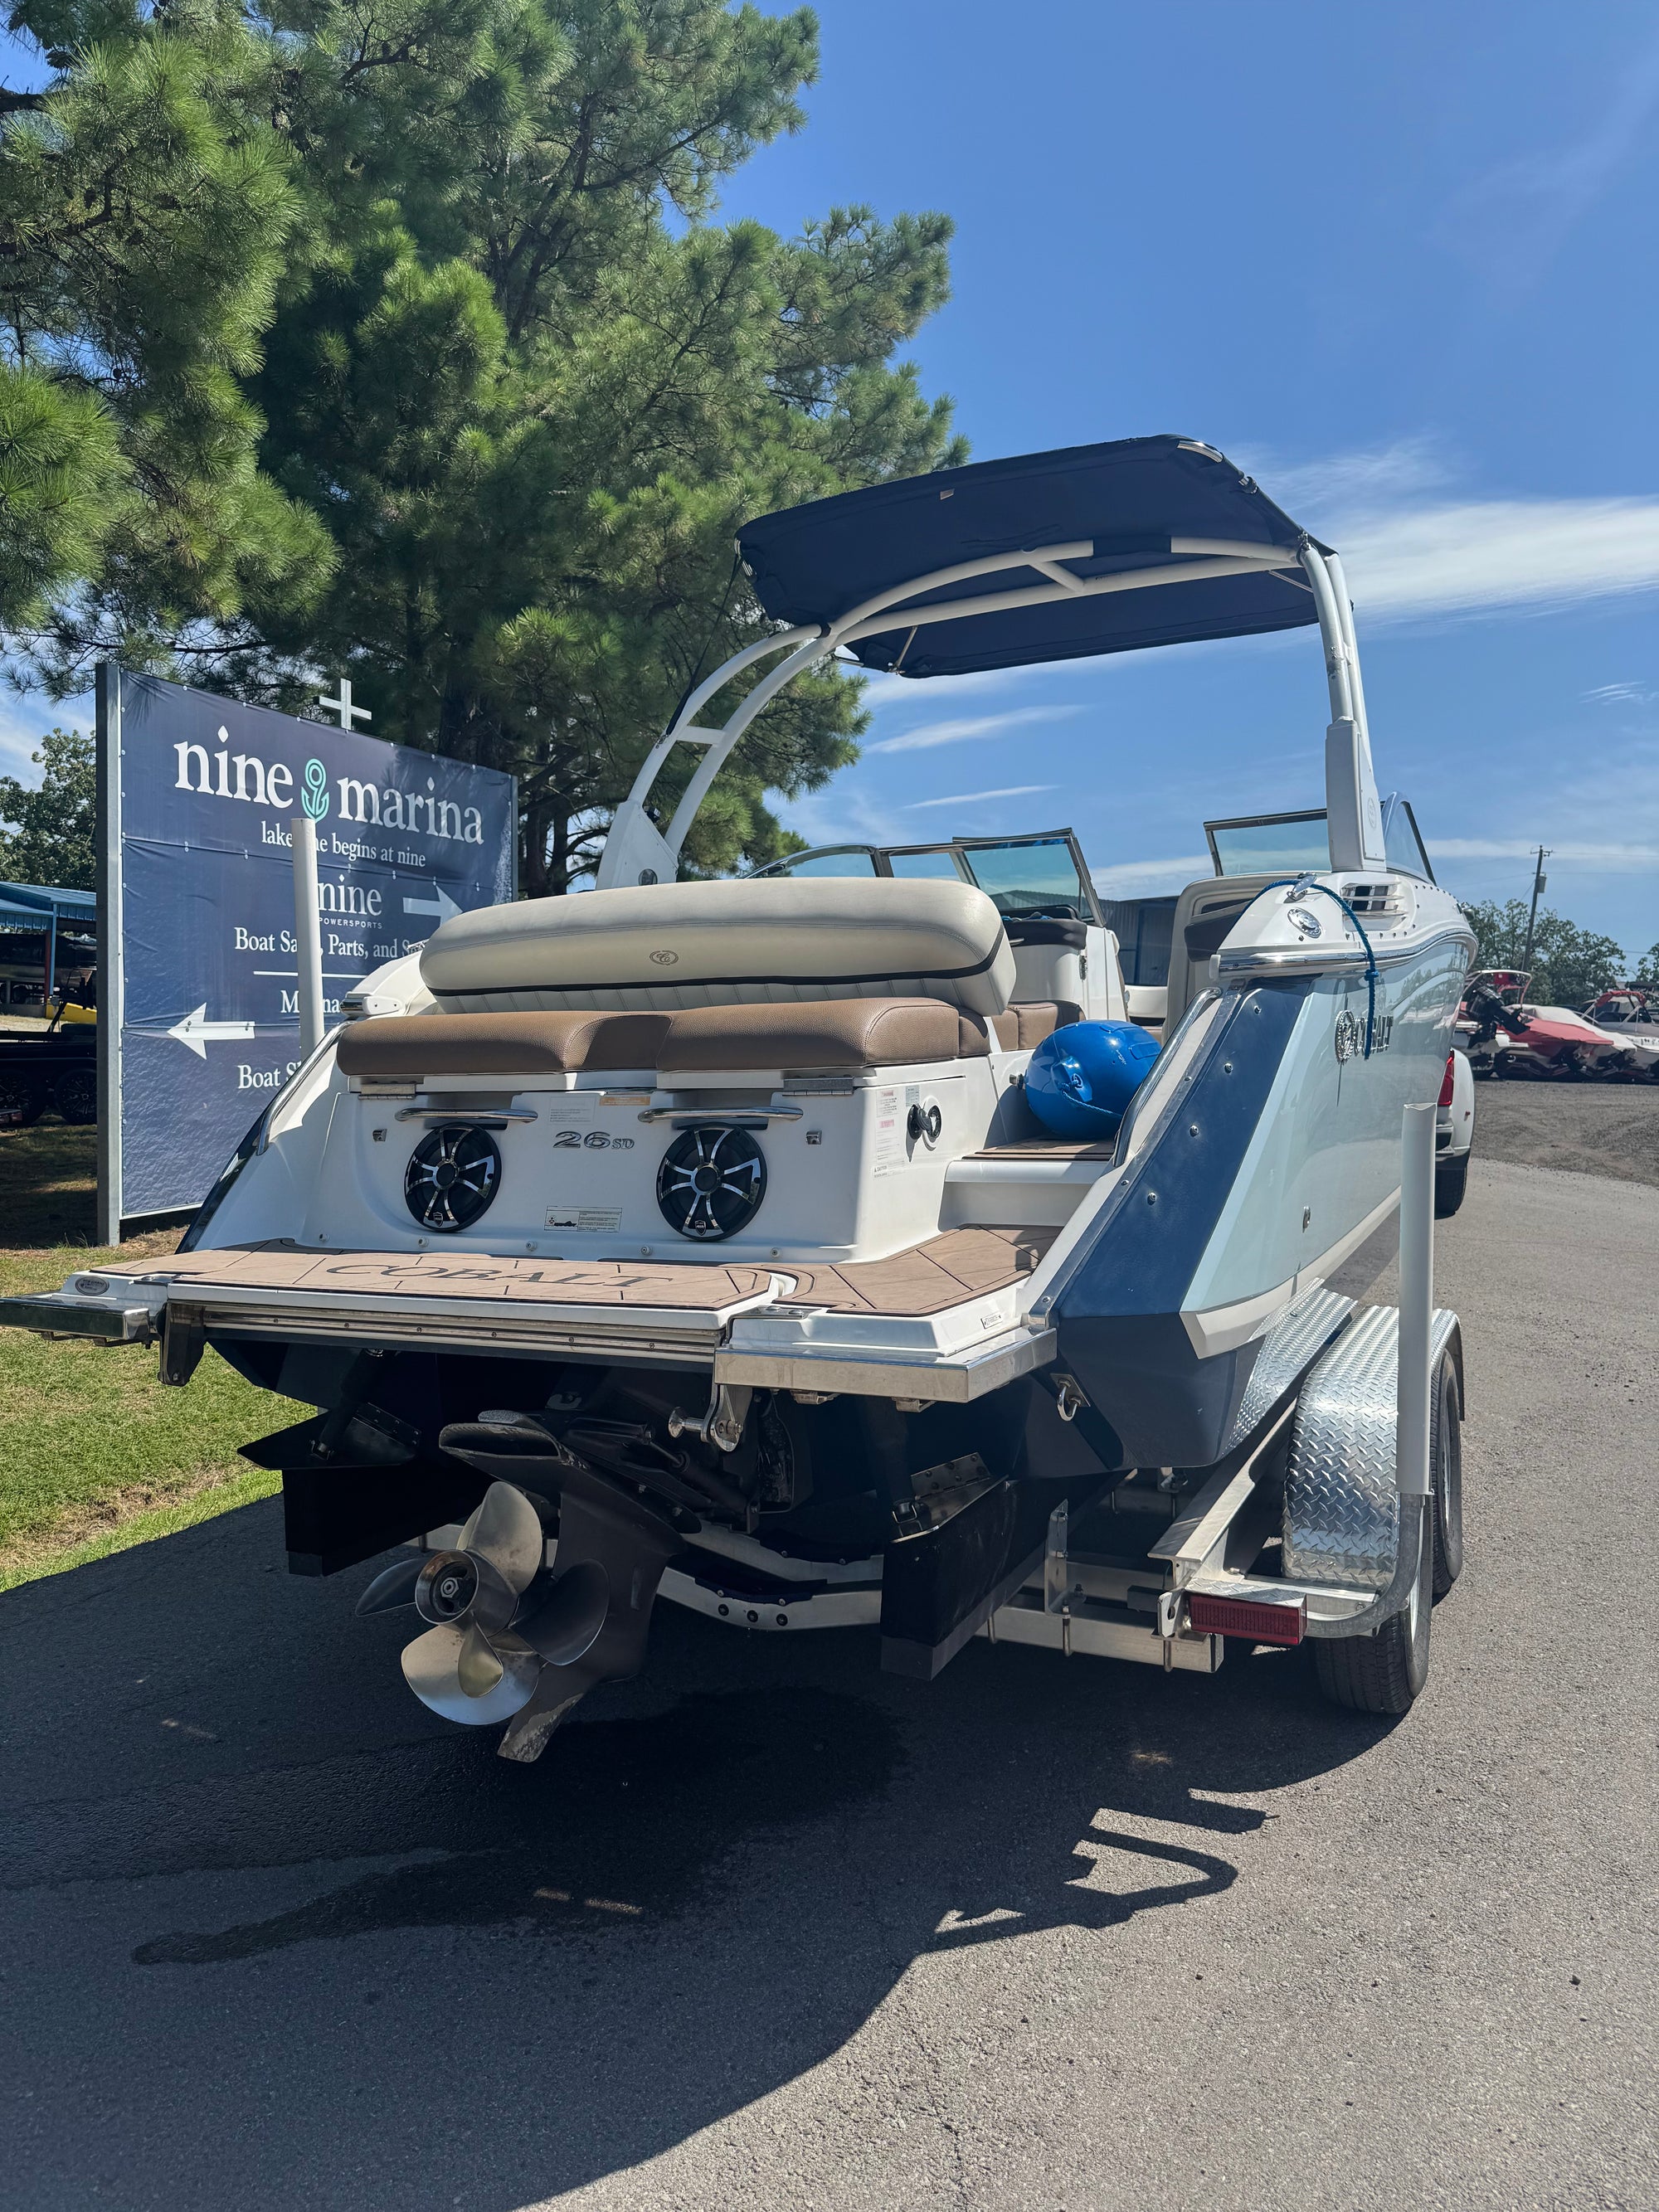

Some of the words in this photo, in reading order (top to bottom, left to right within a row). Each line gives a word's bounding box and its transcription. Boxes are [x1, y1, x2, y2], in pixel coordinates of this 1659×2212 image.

[173, 725, 294, 809] nine
[337, 776, 484, 845] marina
[261, 820, 293, 848] lake
[332, 832, 377, 862] begins
[381, 848, 394, 863] at
[397, 847, 426, 868] nine
[318, 873, 382, 916] nine
[319, 916, 382, 929] POWERSPORTS
[234, 926, 275, 952] Boat
[328, 934, 369, 960] Parts,
[373, 939, 398, 958] and
[237, 1064, 281, 1089] Boat
[326, 1263, 674, 1288] COBALT
